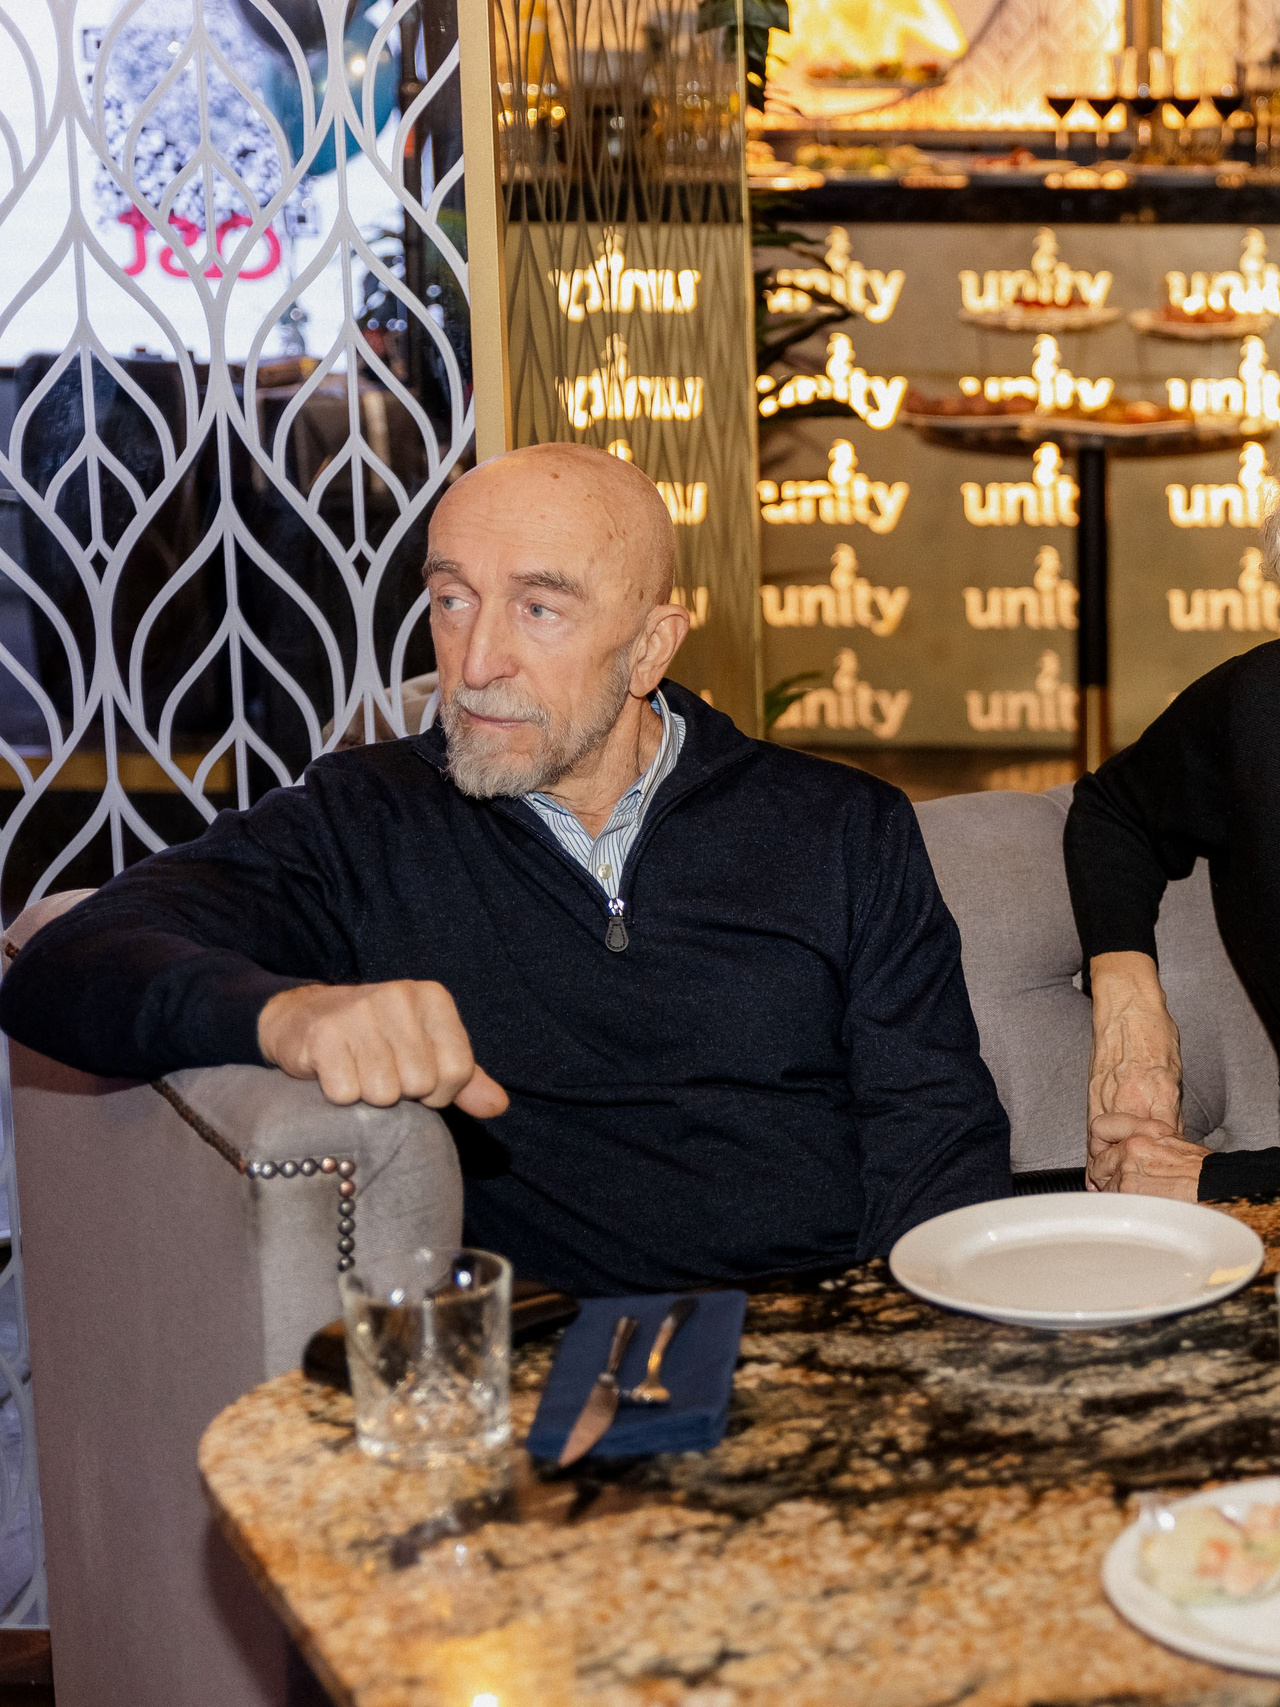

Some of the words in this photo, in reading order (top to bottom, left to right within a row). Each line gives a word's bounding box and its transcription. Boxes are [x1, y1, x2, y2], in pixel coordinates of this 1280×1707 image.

[961, 442, 1080, 527] unit
[761, 544, 911, 637] unity
[964, 545, 1079, 629] unit
[966, 650, 1079, 732] unit
